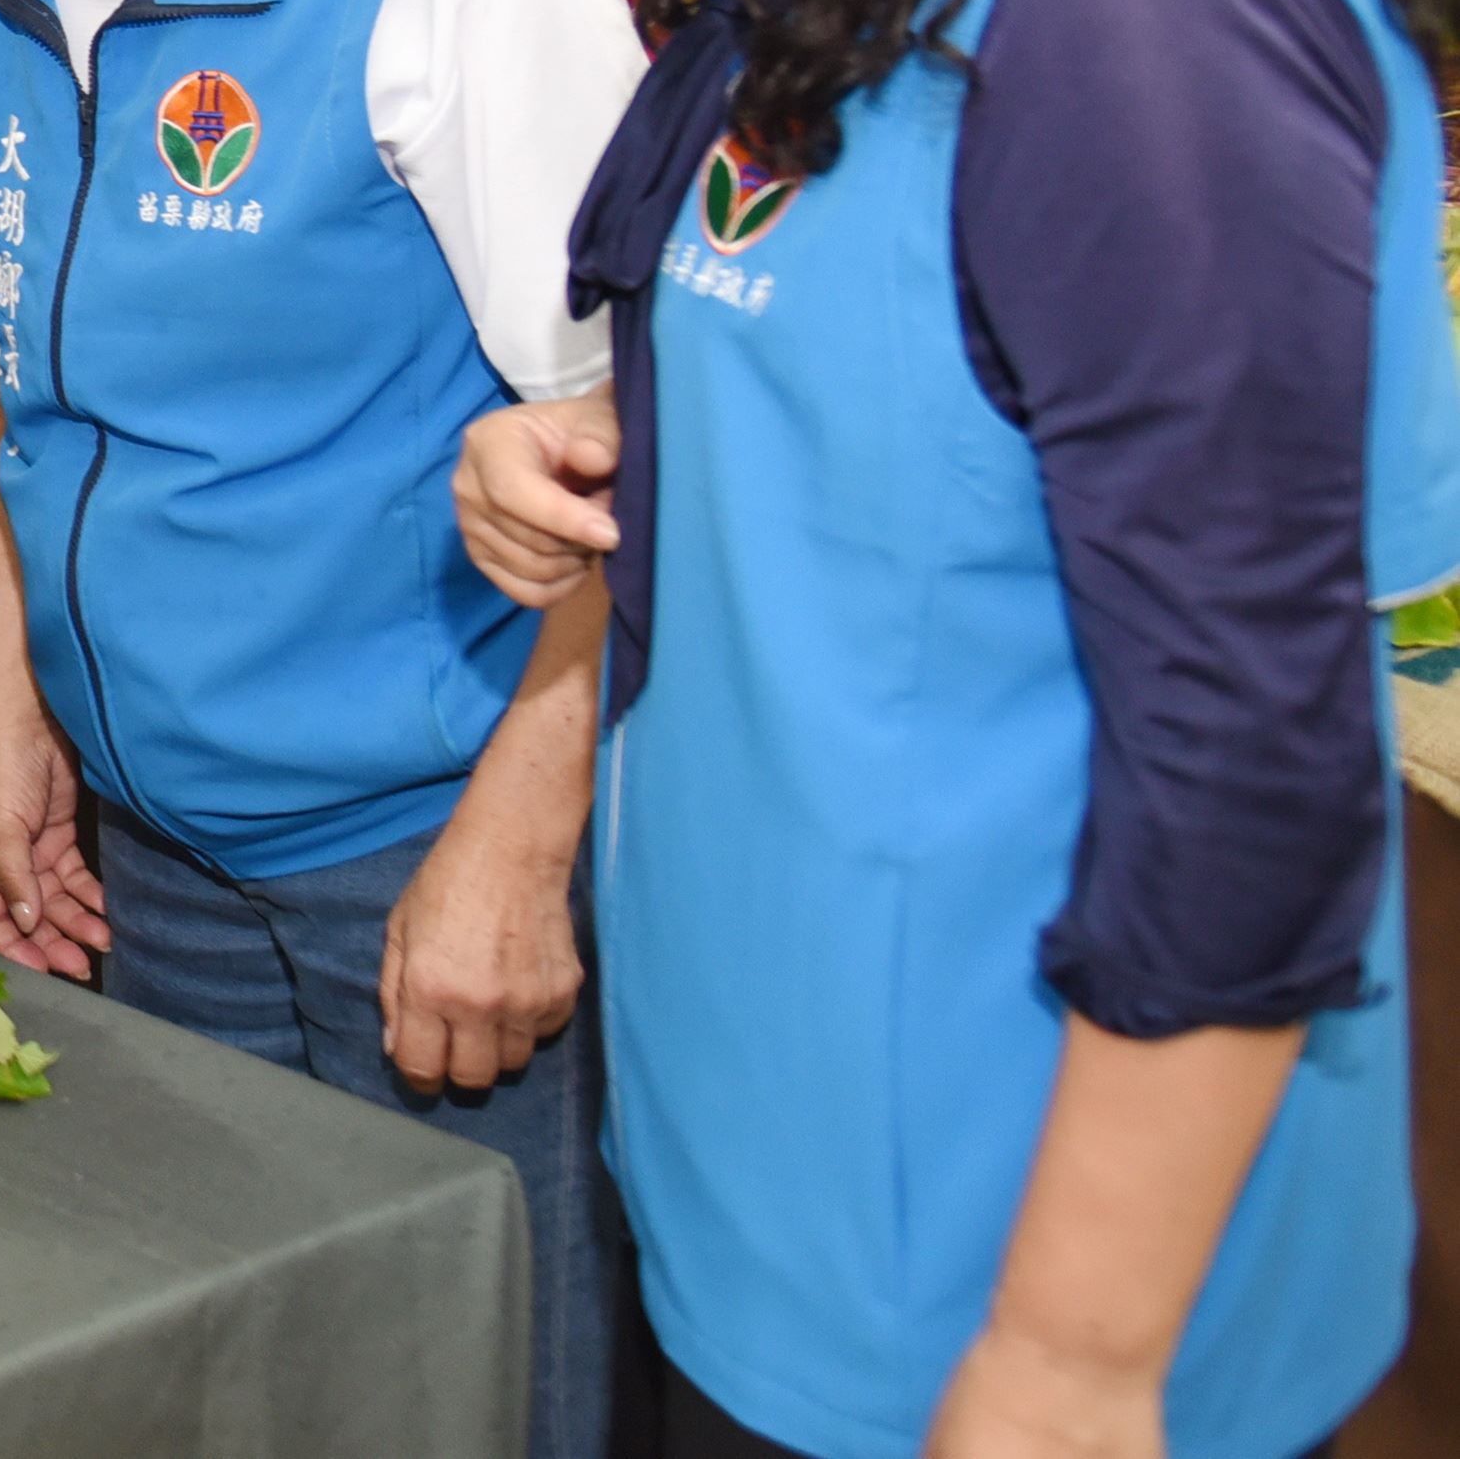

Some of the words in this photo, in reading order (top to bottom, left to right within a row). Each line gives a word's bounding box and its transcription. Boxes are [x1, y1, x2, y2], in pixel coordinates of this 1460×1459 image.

[138, 192, 264, 234] 苗栗縣政府
